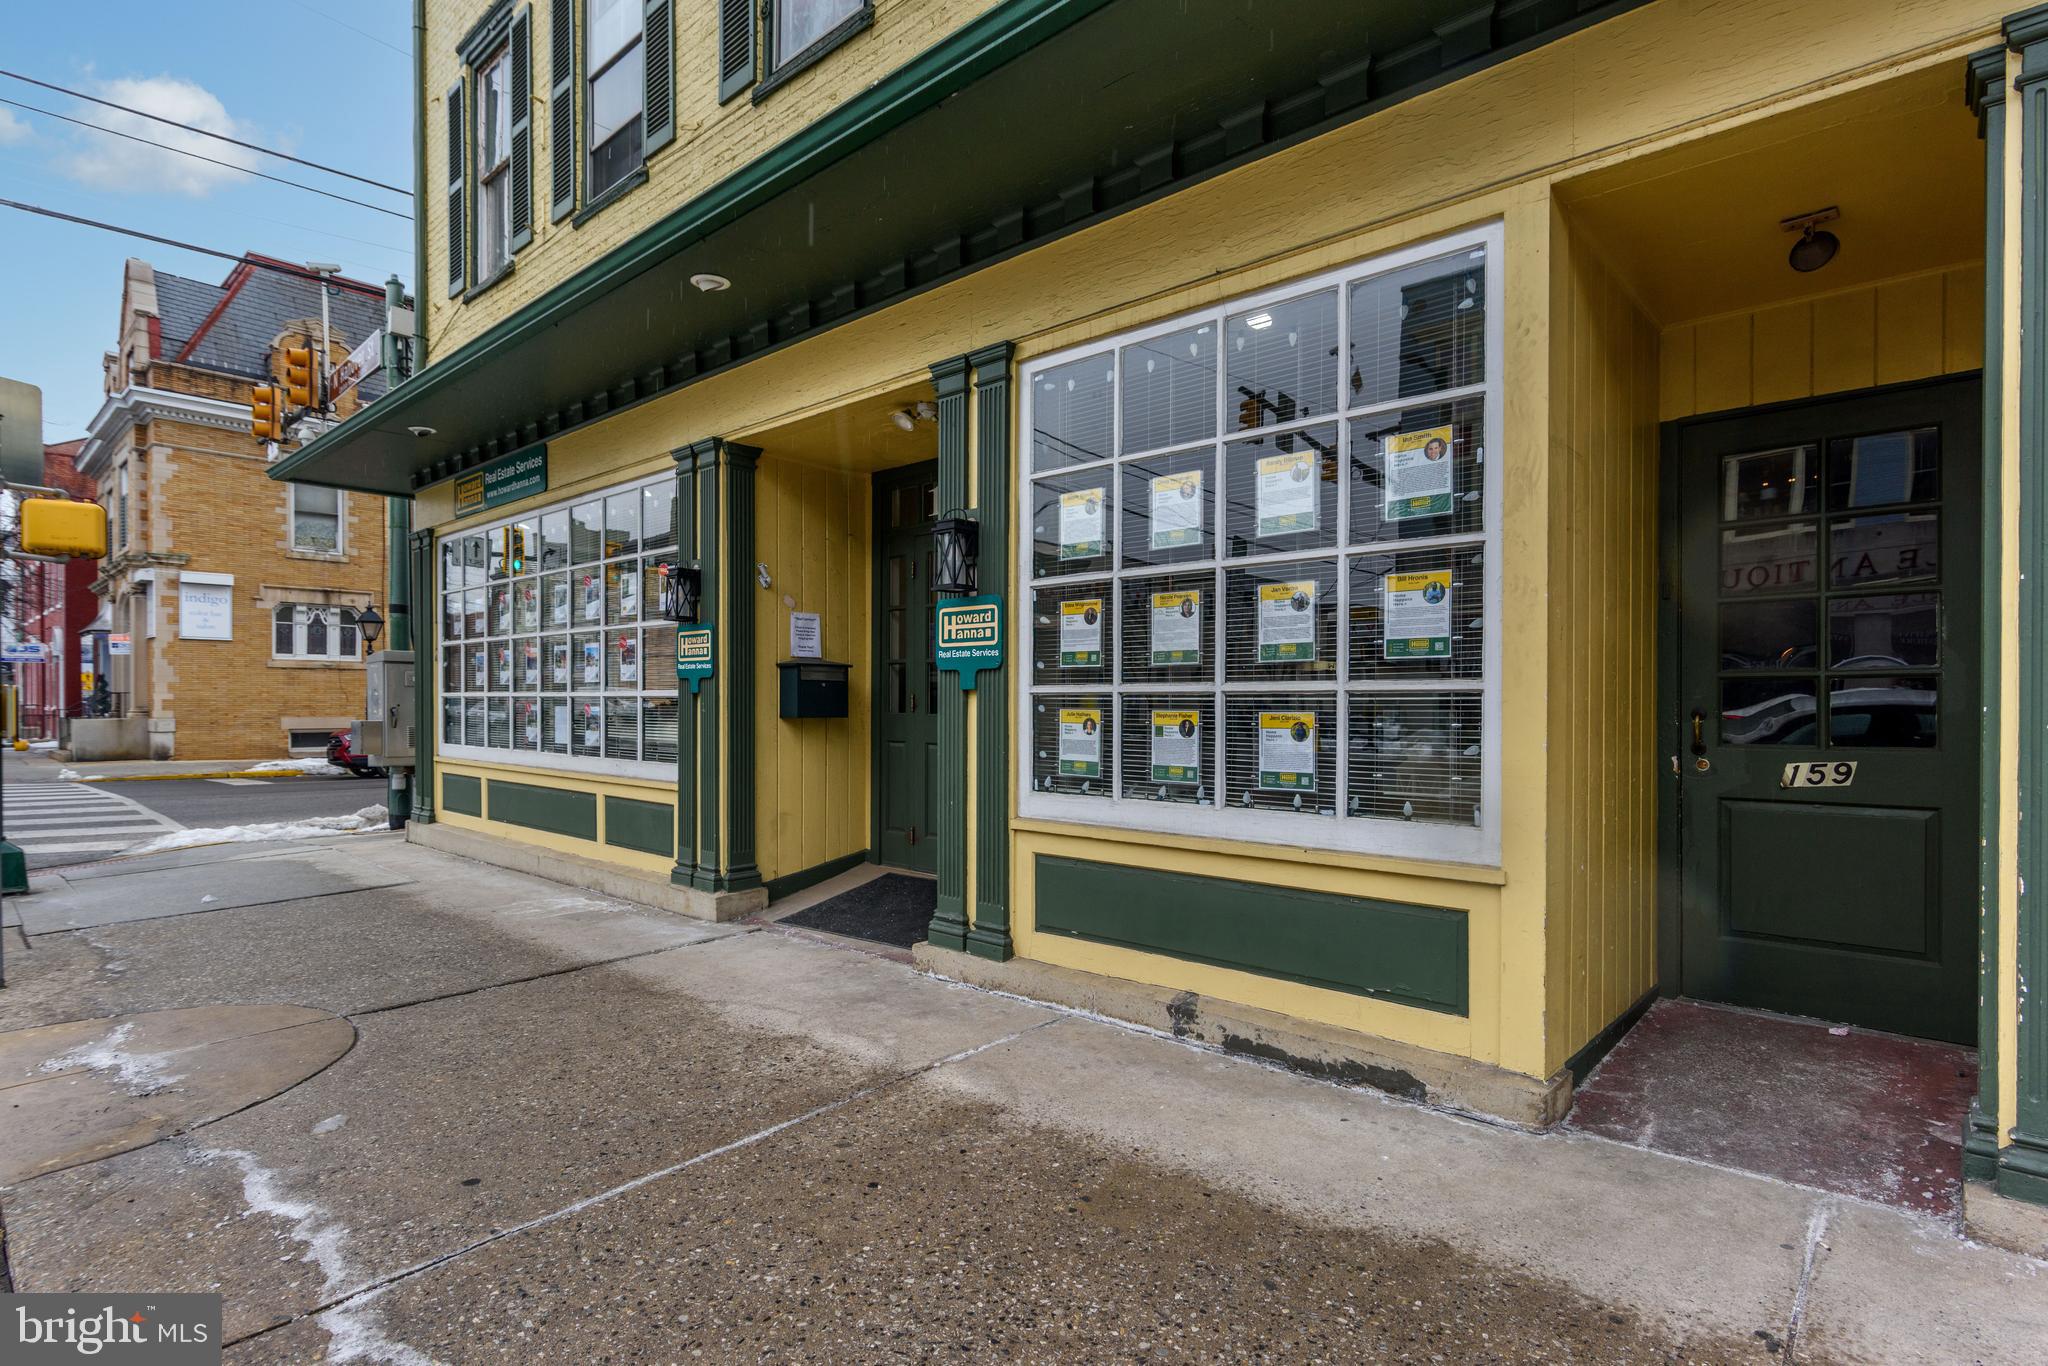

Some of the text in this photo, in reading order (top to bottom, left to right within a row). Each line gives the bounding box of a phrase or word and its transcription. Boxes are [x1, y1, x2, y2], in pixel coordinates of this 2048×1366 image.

[485, 456, 542, 485] Real Estate Services
[185, 592, 228, 607] indigo
[944, 611, 992, 627] Howard
[944, 624, 987, 640] Hanna
[681, 634, 708, 647] Howard
[938, 649, 999, 659] Real Estate Services
[1789, 763, 1852, 786] 159
